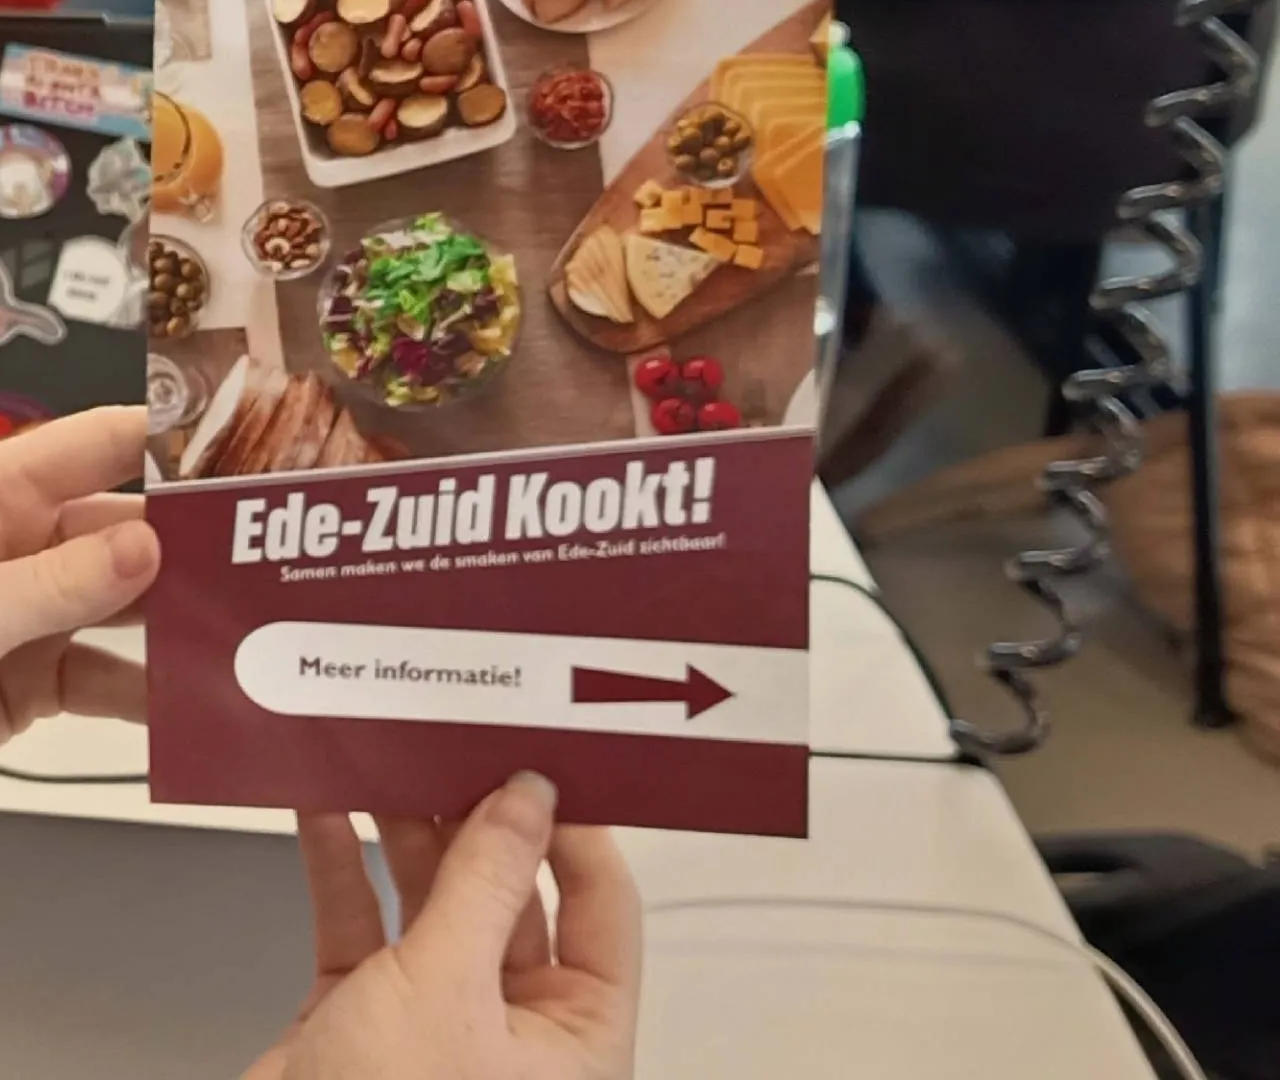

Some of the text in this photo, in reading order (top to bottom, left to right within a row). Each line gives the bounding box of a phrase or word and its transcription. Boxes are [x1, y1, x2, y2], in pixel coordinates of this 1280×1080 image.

[231, 456, 715, 563] Ede-Zuid Kookt!
[280, 565, 337, 583] Samen
[341, 560, 396, 577] maken
[401, 558, 425, 572] we
[430, 553, 450, 571] de
[455, 549, 518, 568] smaken
[523, 548, 554, 563] van
[558, 538, 634, 561] Ede-Zuid
[298, 655, 522, 688] Meer informatie!
